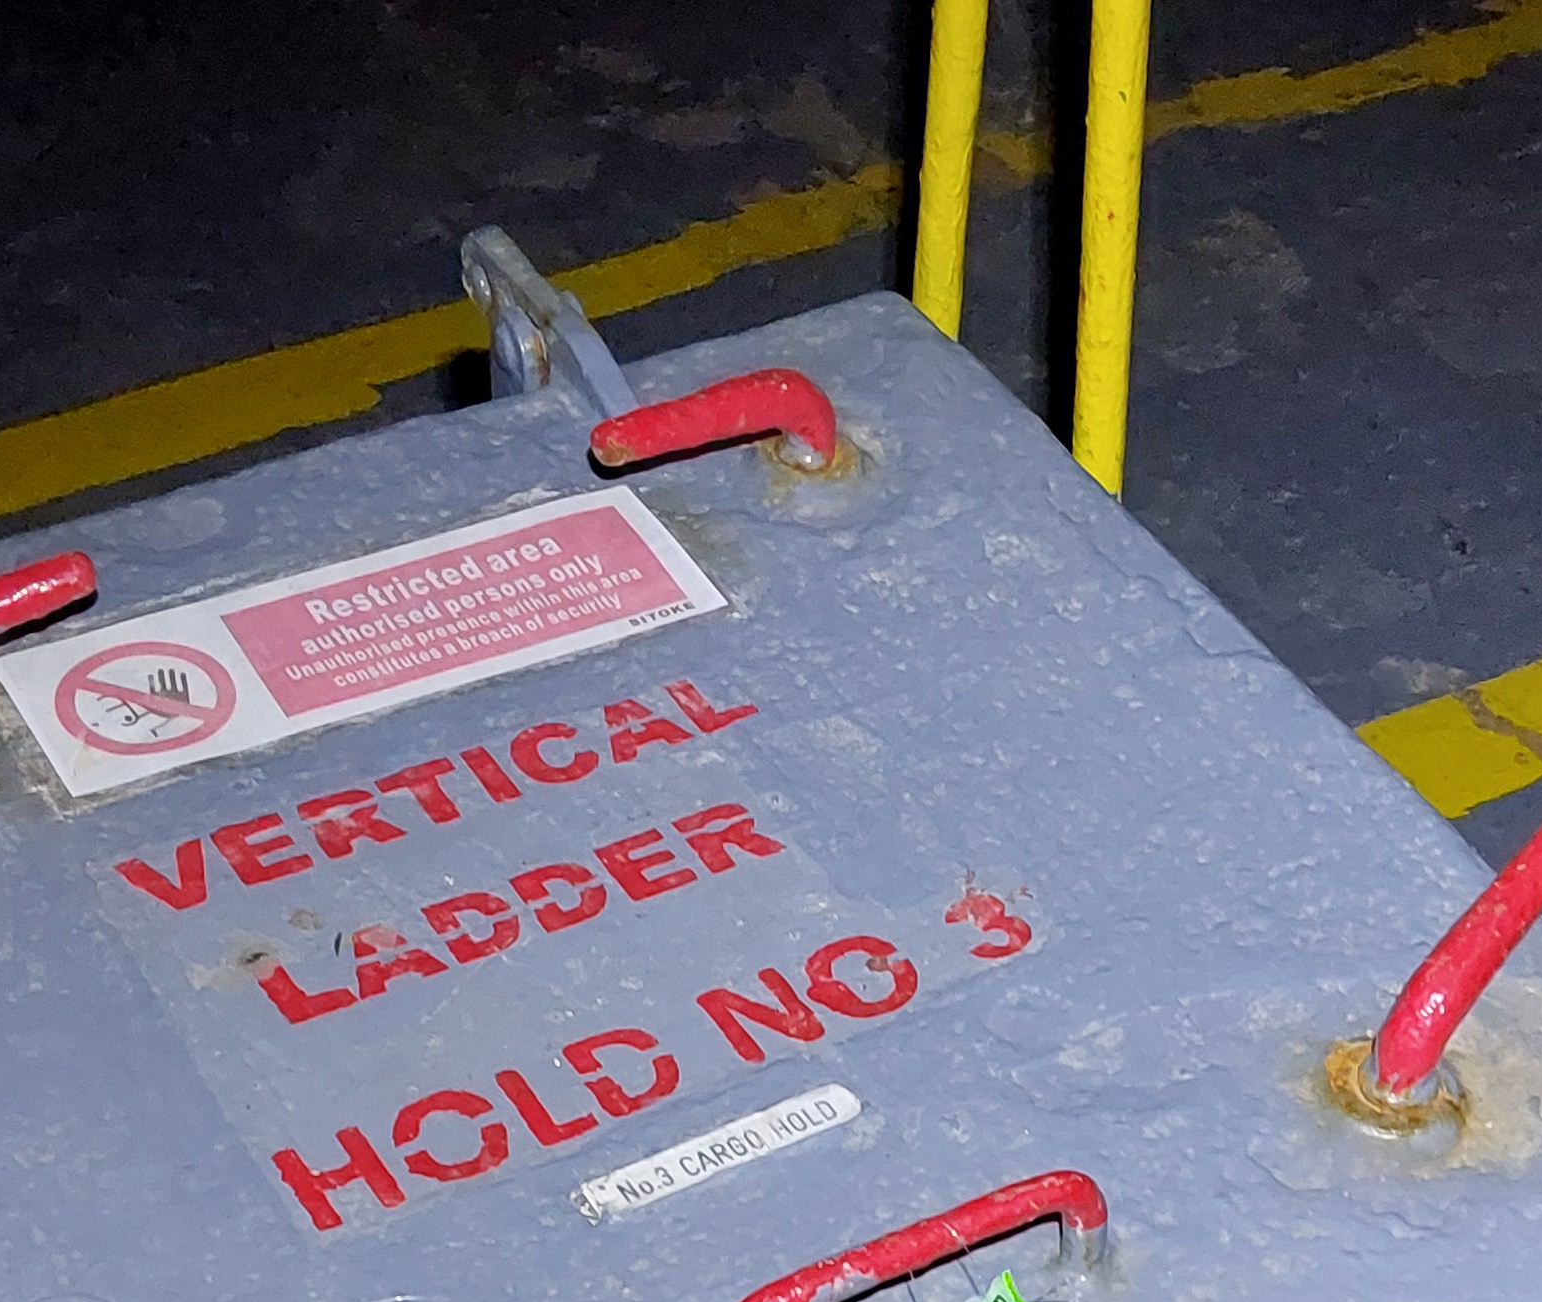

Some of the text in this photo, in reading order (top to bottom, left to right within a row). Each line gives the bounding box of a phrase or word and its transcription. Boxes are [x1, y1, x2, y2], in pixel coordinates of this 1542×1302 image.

[284, 567, 644, 681] Unauthorised presence within this area
[300, 553, 605, 656] authorised persons only
[304, 536, 563, 625] Restricted area
[333, 592, 623, 688] constitutes a breach of security
[113, 678, 759, 911] VERTICAL
[256, 803, 787, 1025] LADDER
[270, 892, 1034, 1231] HOLD NO 3
[616, 1099, 839, 1204] No.3 CARGO HOLD
